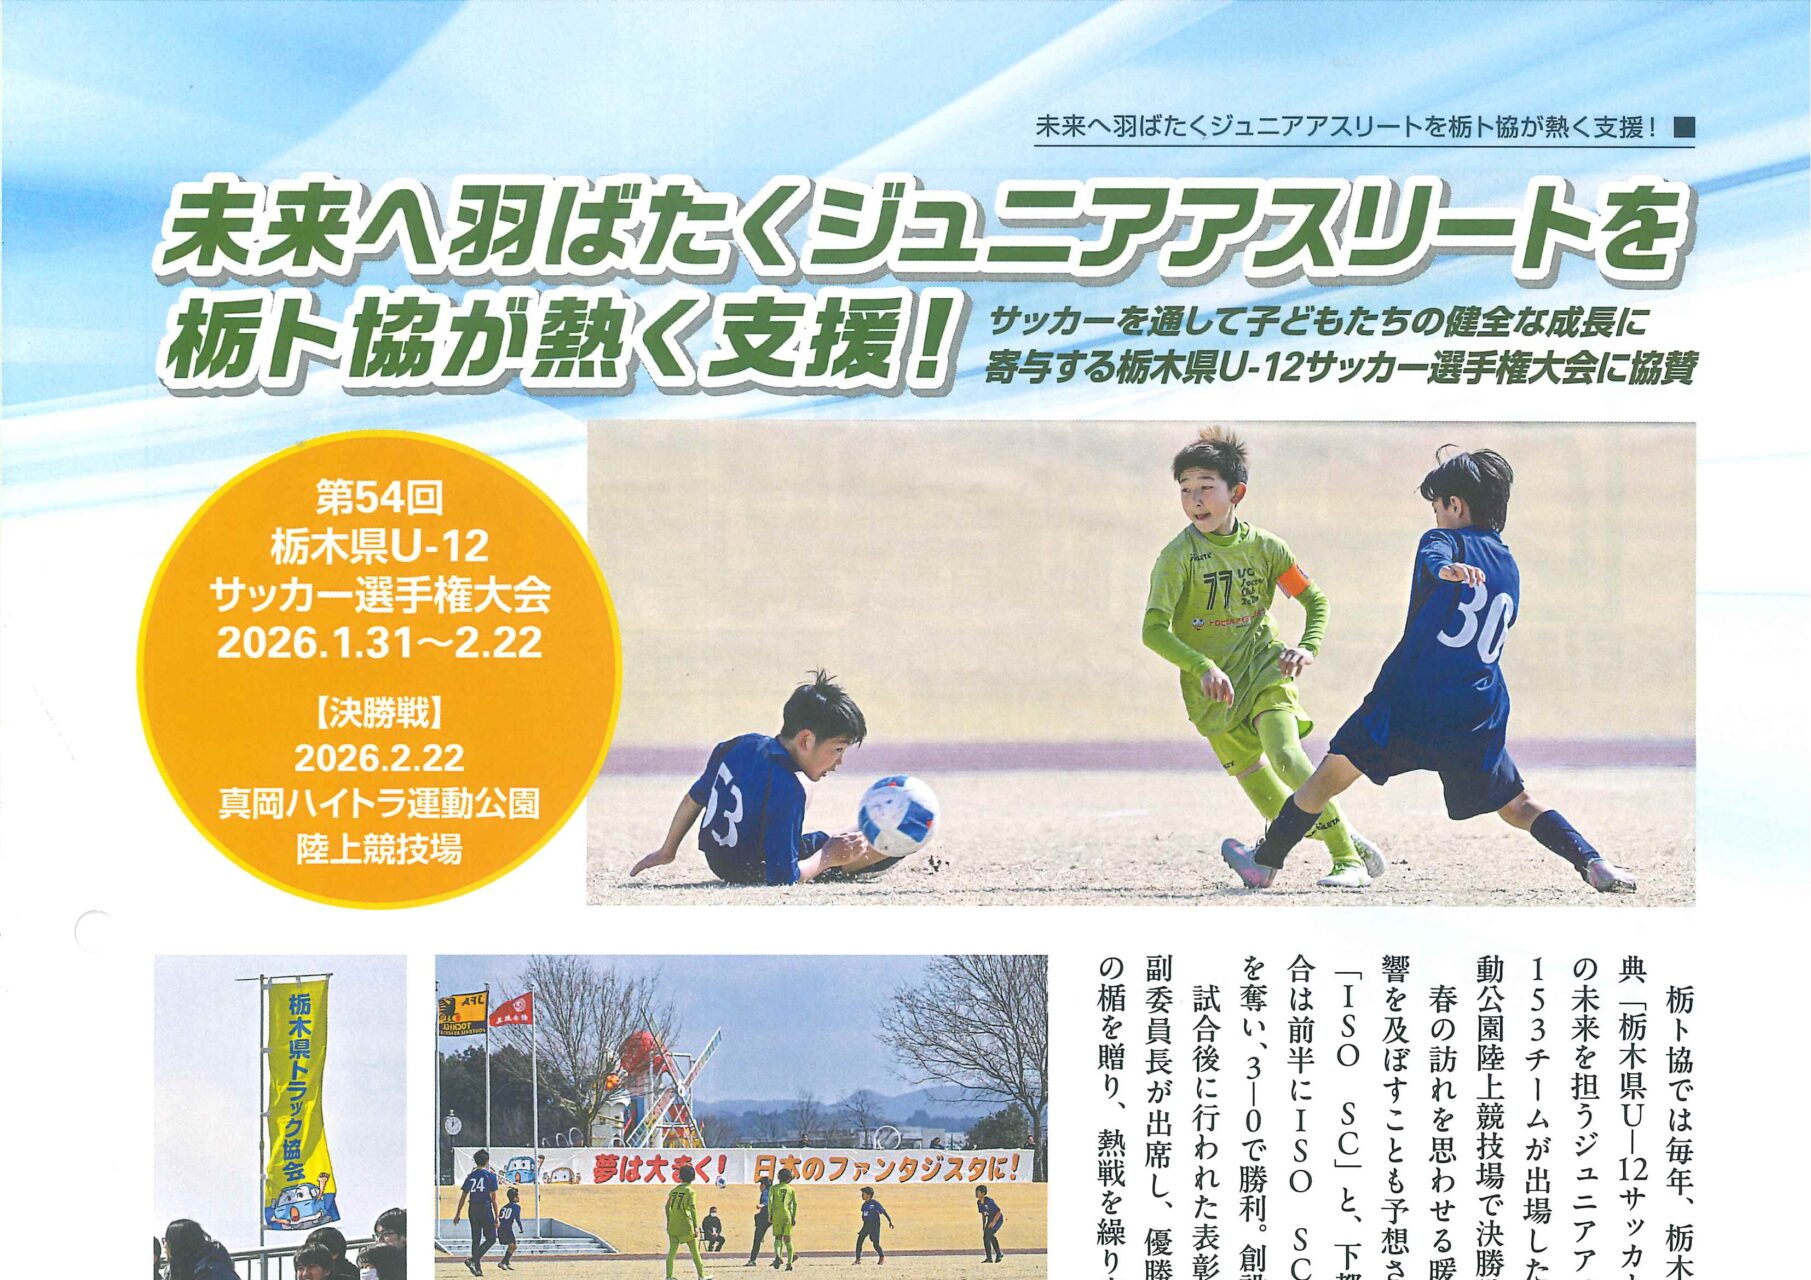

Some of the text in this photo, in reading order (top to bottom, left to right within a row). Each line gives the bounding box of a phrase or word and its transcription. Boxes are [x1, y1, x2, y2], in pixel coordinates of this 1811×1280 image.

[1036, 114, 1654, 138] 未来へ羽ばたくジュニアアスリートを栃ト協が熱く支援！
[163, 183, 1679, 269] 未来へ羽ばたくジュニアアスリートを
[167, 297, 953, 378] 栃ト協が熱く支援！
[991, 306, 1650, 337] サッカーを通して子どもたちの健全な成長に
[985, 349, 1699, 385] 寄与する栃木県U-12サッカー選手権大会に協賛
[317, 479, 442, 515] 第54回
[272, 528, 488, 564] 栃木県U-12
[211, 576, 550, 613] サッカー選手権大会
[1203, 570, 1232, 610] 77
[1436, 583, 1513, 664] 30
[319, 696, 440, 729] 【決勝戦】
[296, 744, 463, 771] 2026.2.22
[220, 787, 539, 819] 真岡ハイトラ運動公園
[298, 833, 461, 864] 陸上競技場
[282, 993, 312, 1181] 栃木県トラック協会
[1288, 954, 1315, 1192] 合は前半にISO
[470, 1177, 486, 1193] 24
[499, 1207, 513, 1220] 30
